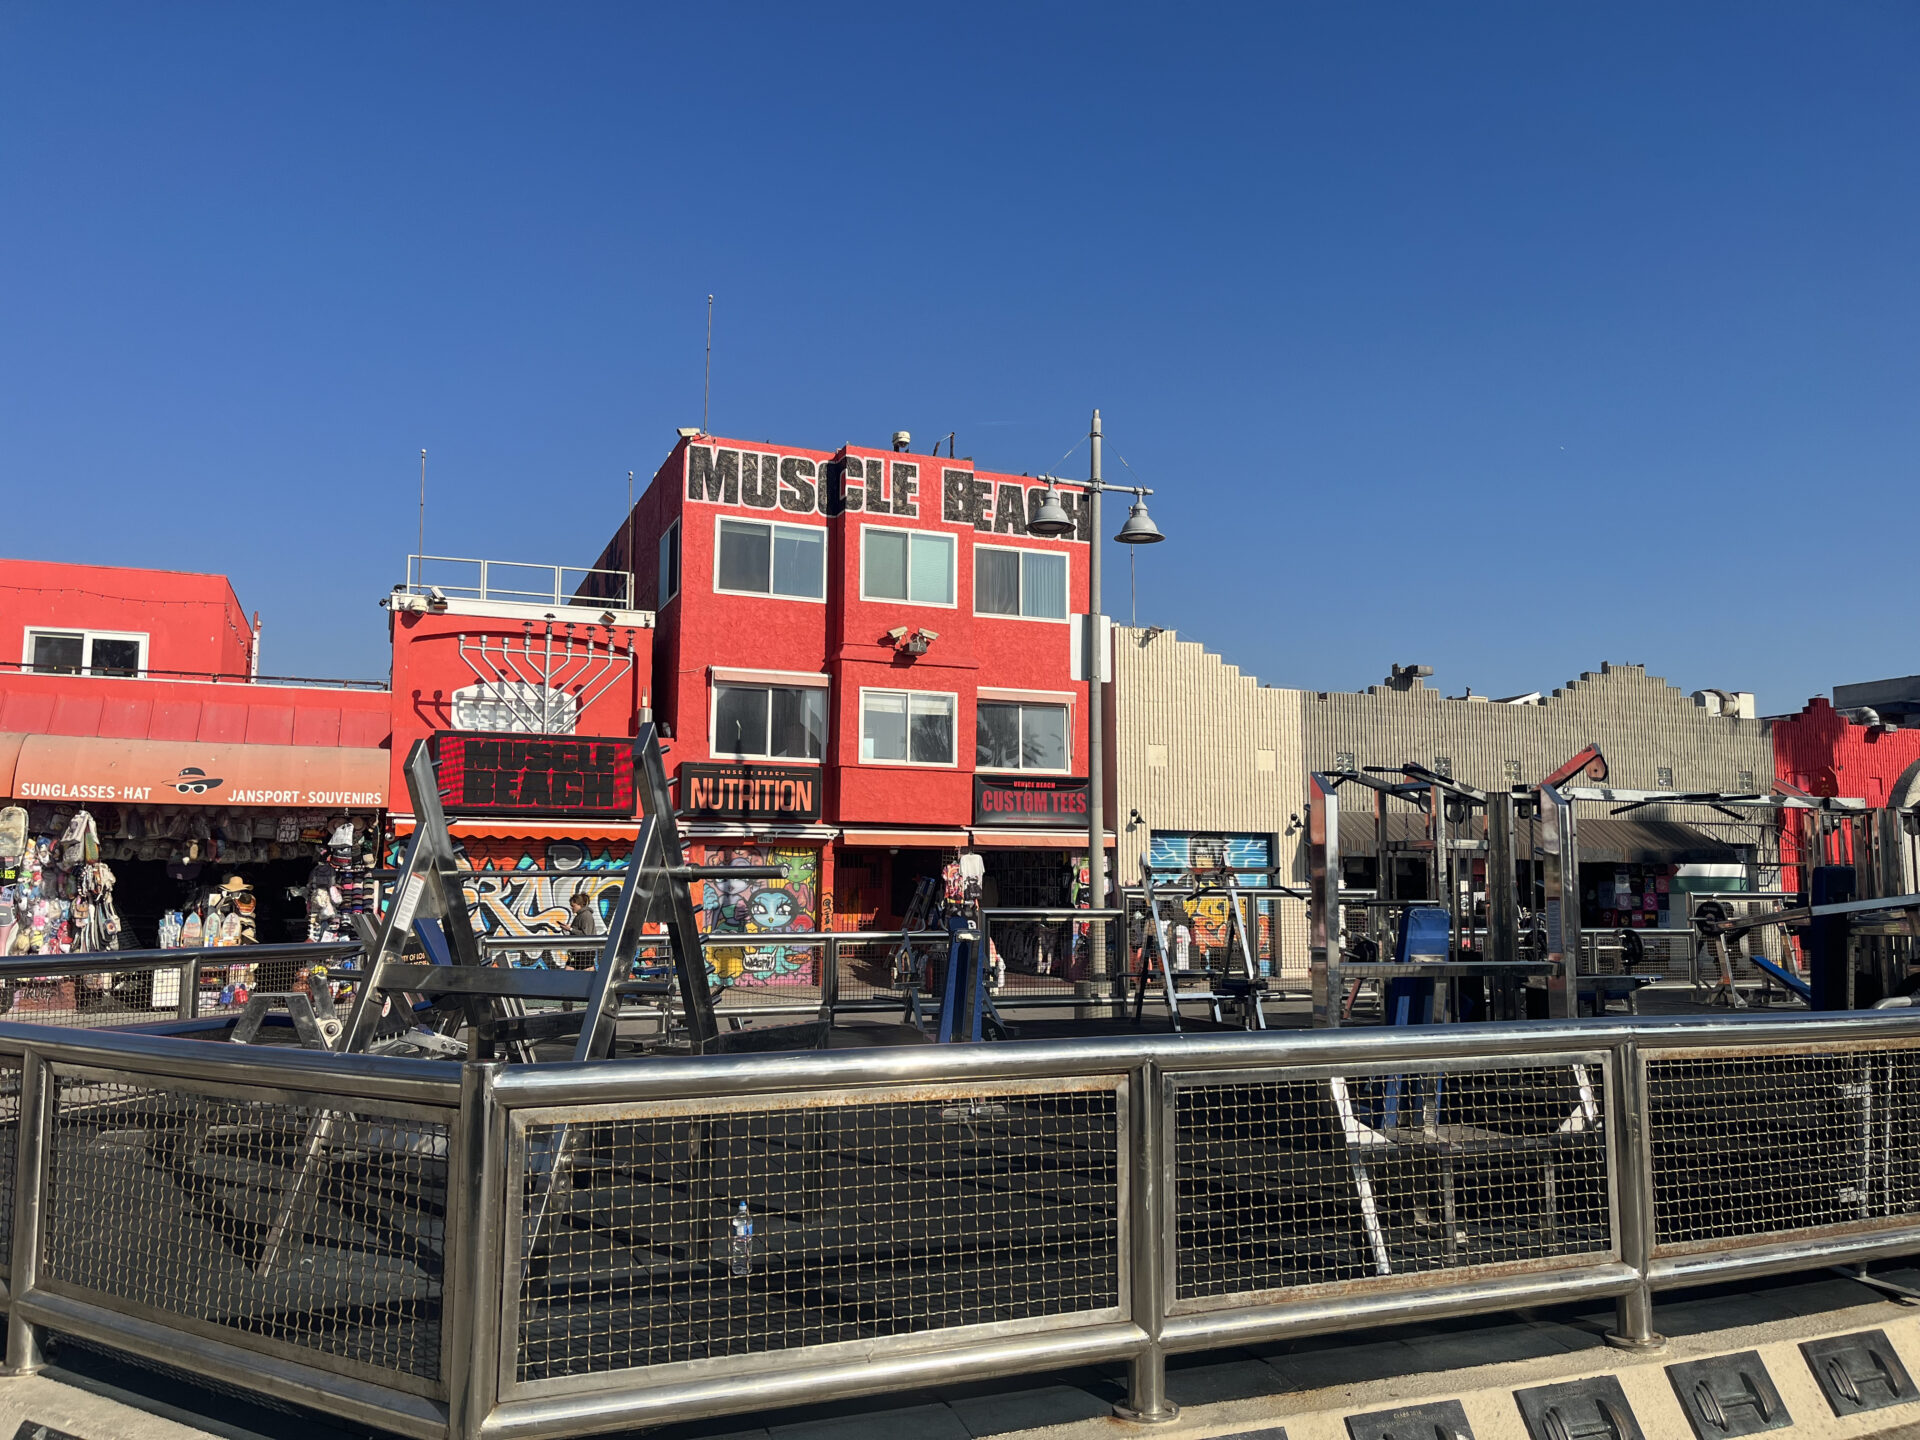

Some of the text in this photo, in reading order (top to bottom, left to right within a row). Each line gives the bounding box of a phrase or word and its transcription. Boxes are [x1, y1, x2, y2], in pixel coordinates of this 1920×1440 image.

[687, 444, 919, 519] MUSCLE
[463, 740, 615, 773] MUSCLE
[21, 783, 382, 805] SUNGLASSES HAT JANSPORT SOUVENIRS
[462, 770, 614, 807] BEACH
[690, 777, 812, 811] NUTRITION
[982, 790, 1086, 813] CUSTOM TEES
